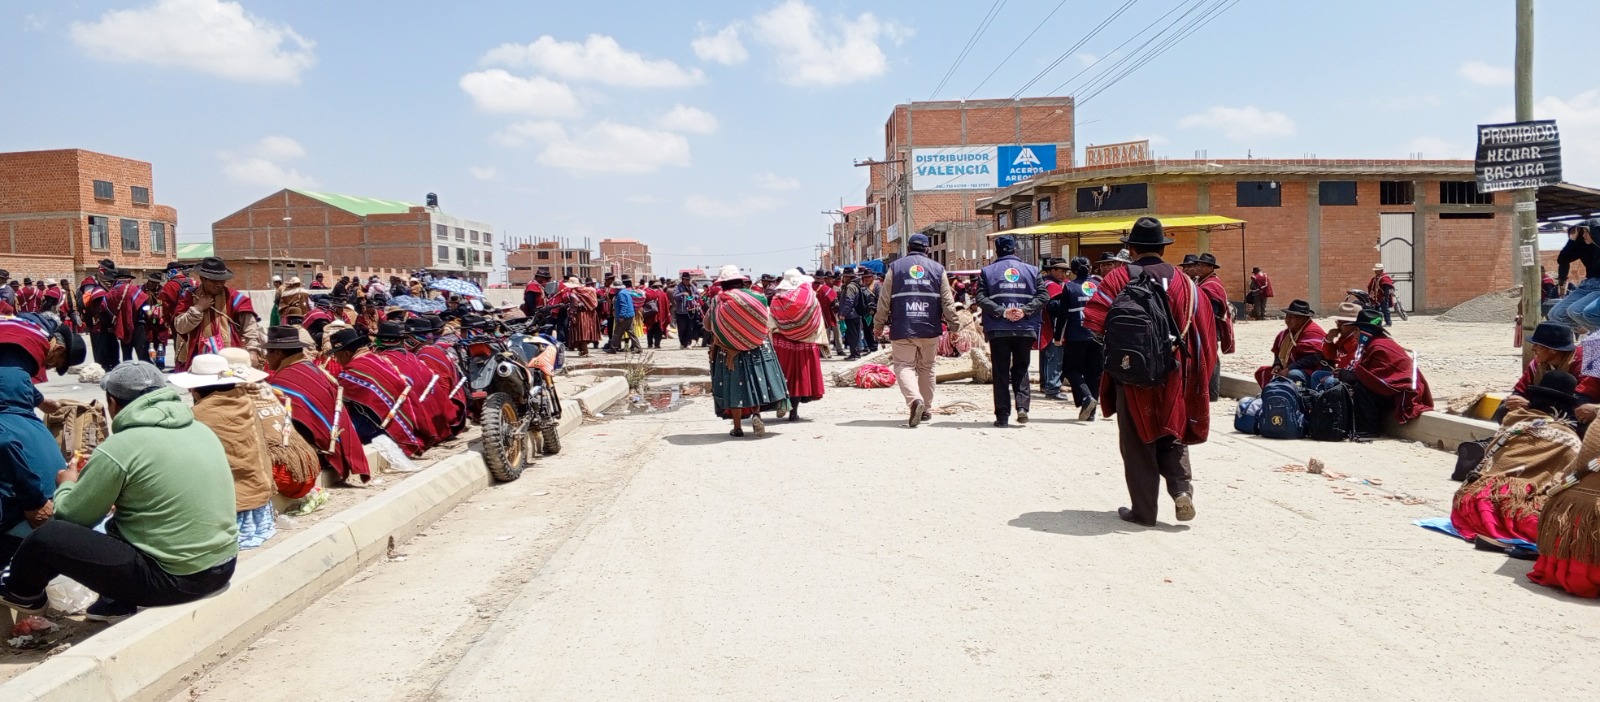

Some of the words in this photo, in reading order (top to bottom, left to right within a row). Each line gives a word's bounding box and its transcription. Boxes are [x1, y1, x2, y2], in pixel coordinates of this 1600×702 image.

[1481, 125, 1555, 145] PROHIBIDO
[916, 153, 989, 162] DISTRIBUIDOR
[1087, 144, 1145, 166] BARRACA
[1487, 146, 1541, 162] HECHAR
[917, 164, 990, 176] VALENCIA
[1010, 166, 1044, 174] ACEROS
[1484, 163, 1545, 181] BASURA
[906, 302, 930, 311] MNP
